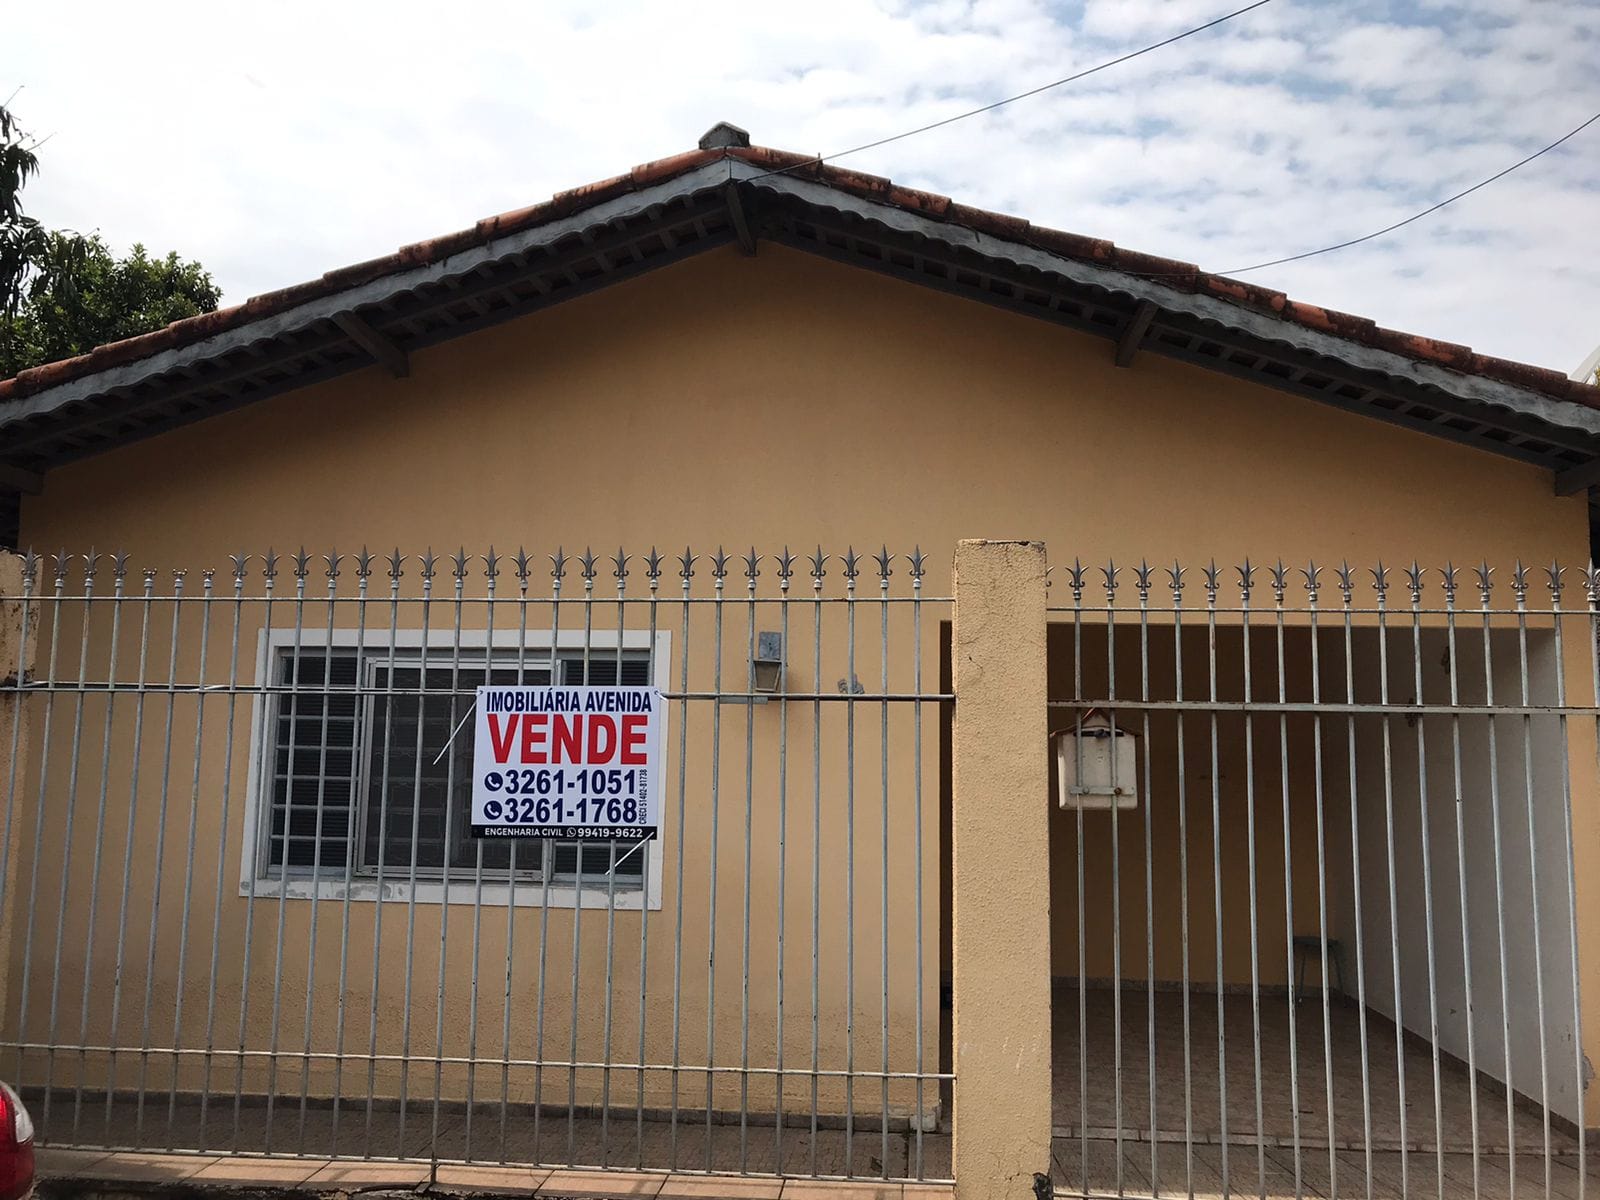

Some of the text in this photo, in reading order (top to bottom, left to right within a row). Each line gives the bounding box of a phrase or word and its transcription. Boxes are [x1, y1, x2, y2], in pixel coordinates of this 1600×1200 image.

[486, 688, 652, 713] IMOBILIÁRIA AVENIDA
[487, 714, 648, 765] VENDE
[504, 769, 636, 795] 3261-1051
[504, 798, 637, 823] 3261-1768
[638, 808, 648, 825] CRECI
[485, 828, 643, 838] ENGENHARIA CIVIL 99419-9622
